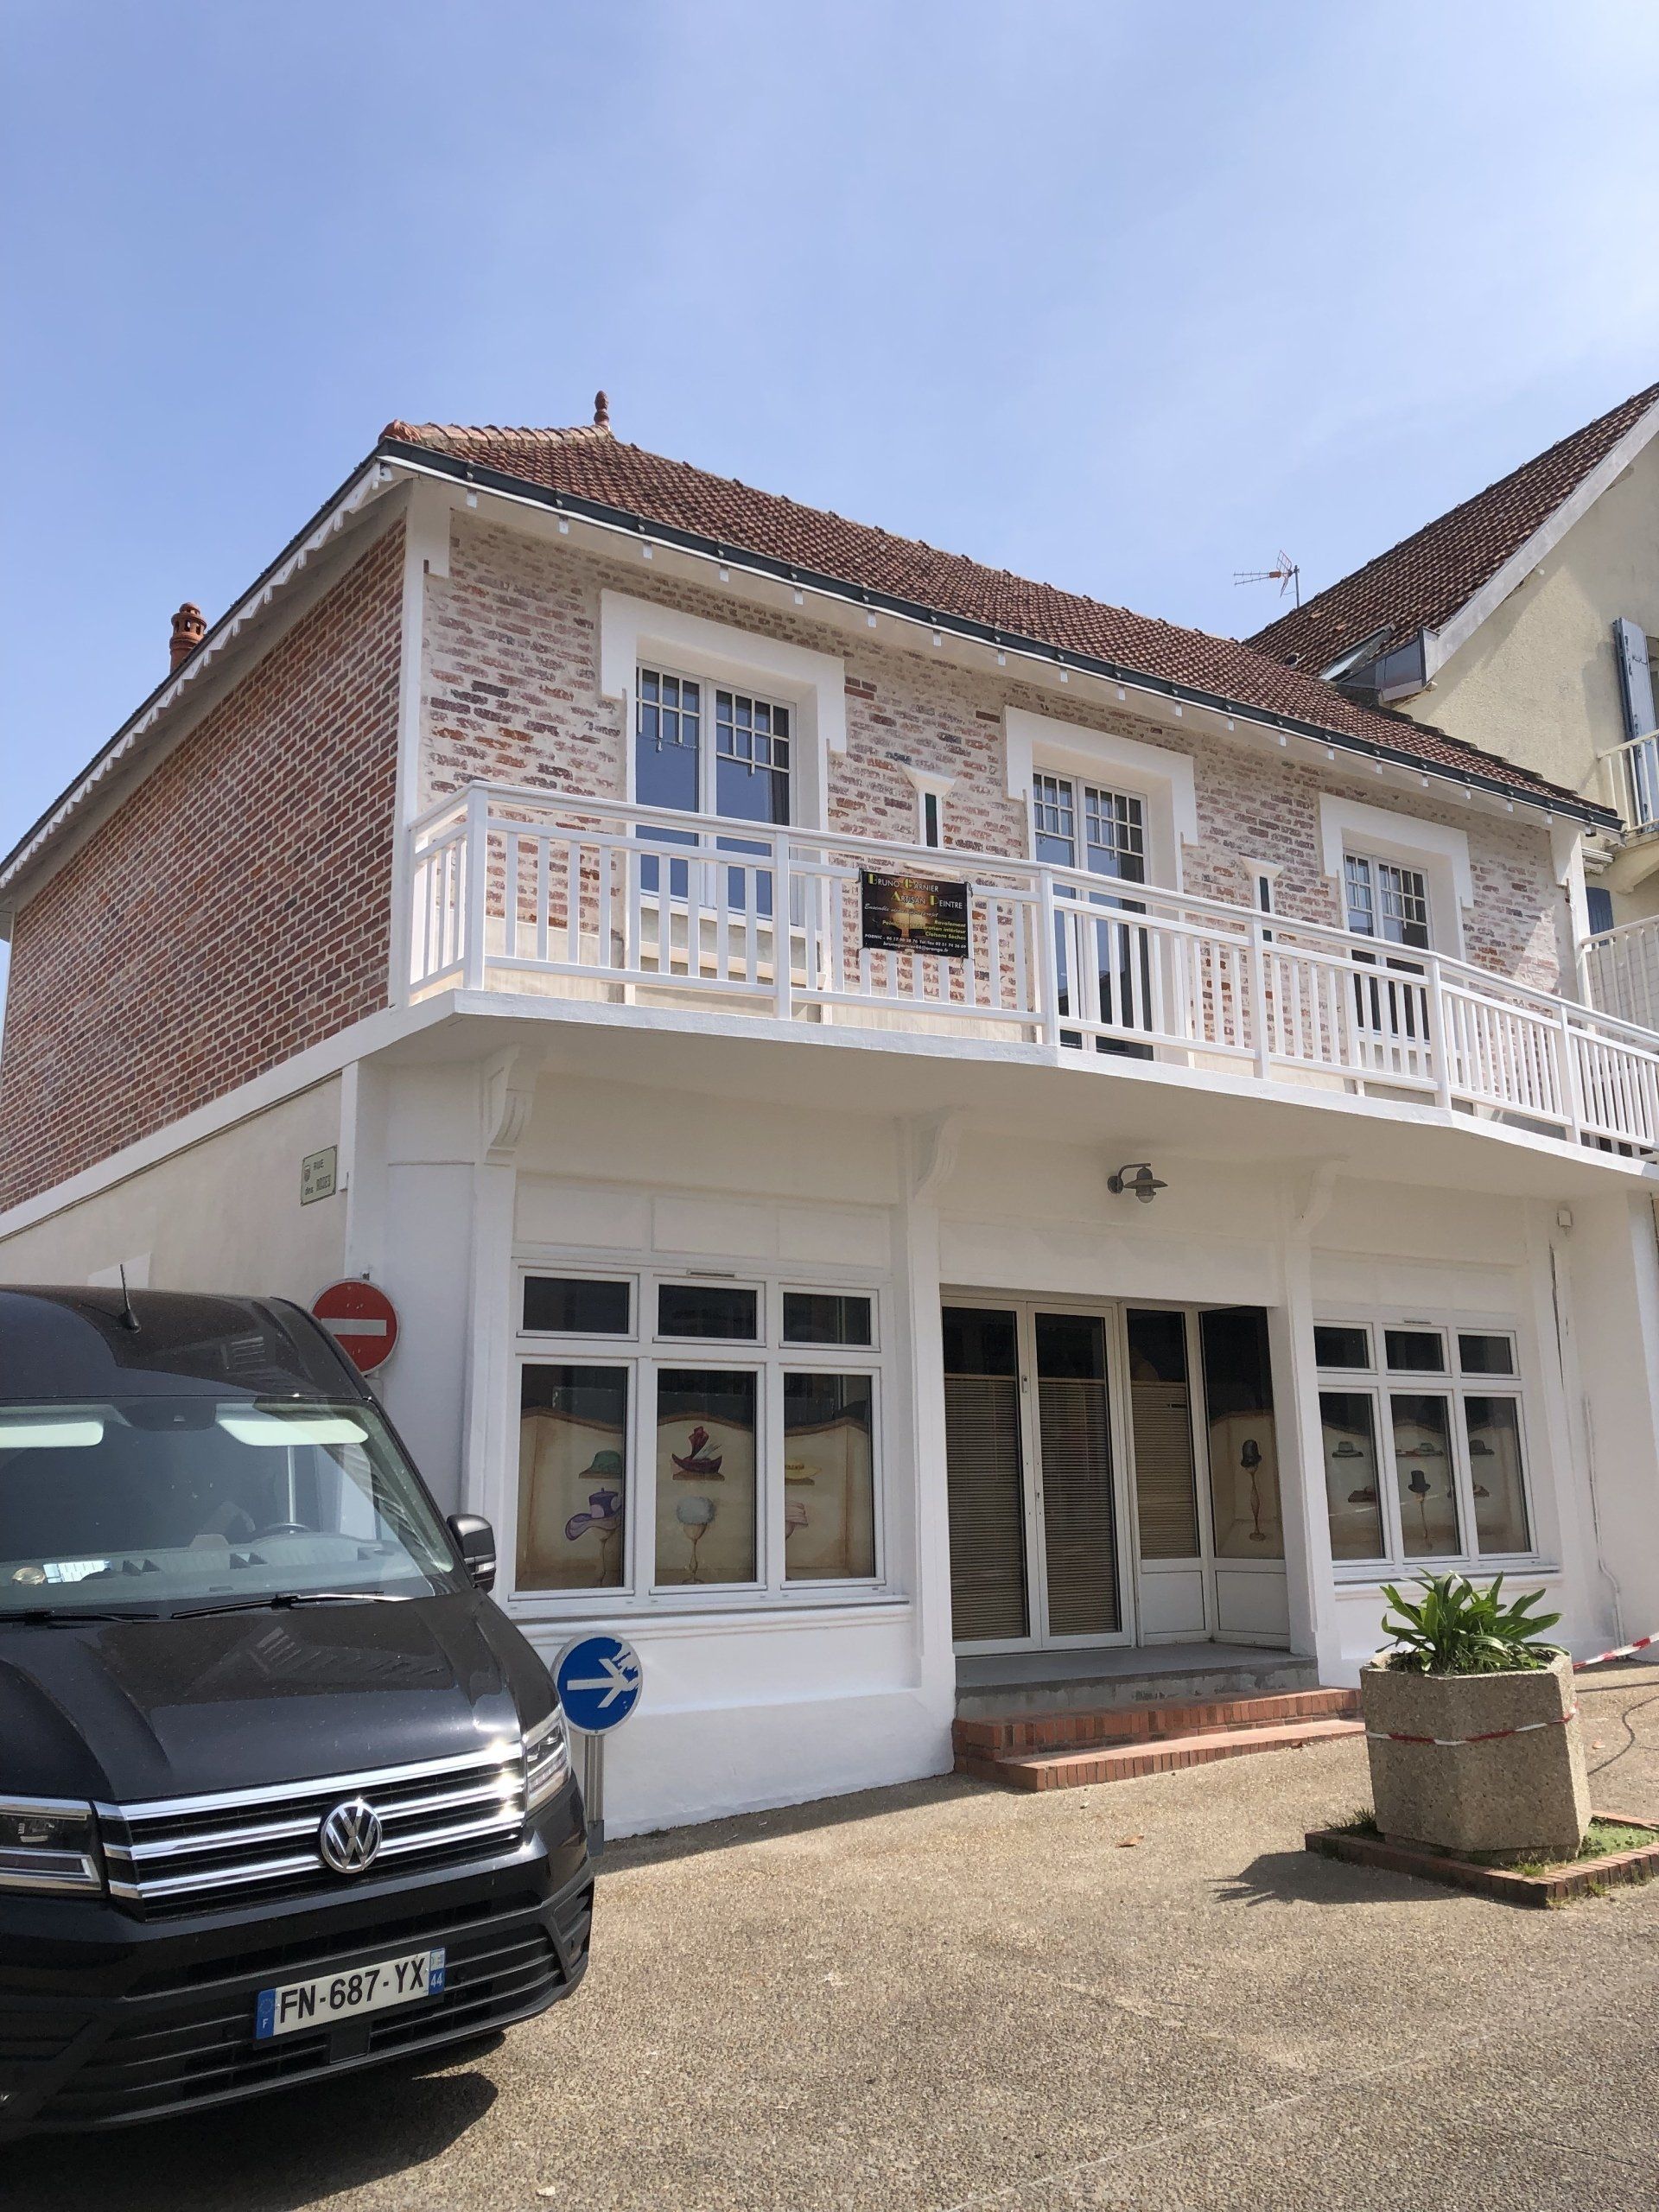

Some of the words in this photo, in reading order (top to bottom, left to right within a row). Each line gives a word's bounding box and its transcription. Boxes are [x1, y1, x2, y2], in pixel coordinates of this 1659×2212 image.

[868, 874, 900, 888] BRUNO
[892, 891, 925, 905] ARTISAN
[930, 895, 963, 909] PEINTRE
[430, 1972, 443, 1988] 44
[280, 1958, 425, 2024] FN-687-YX
[263, 2018, 268, 2029] F
